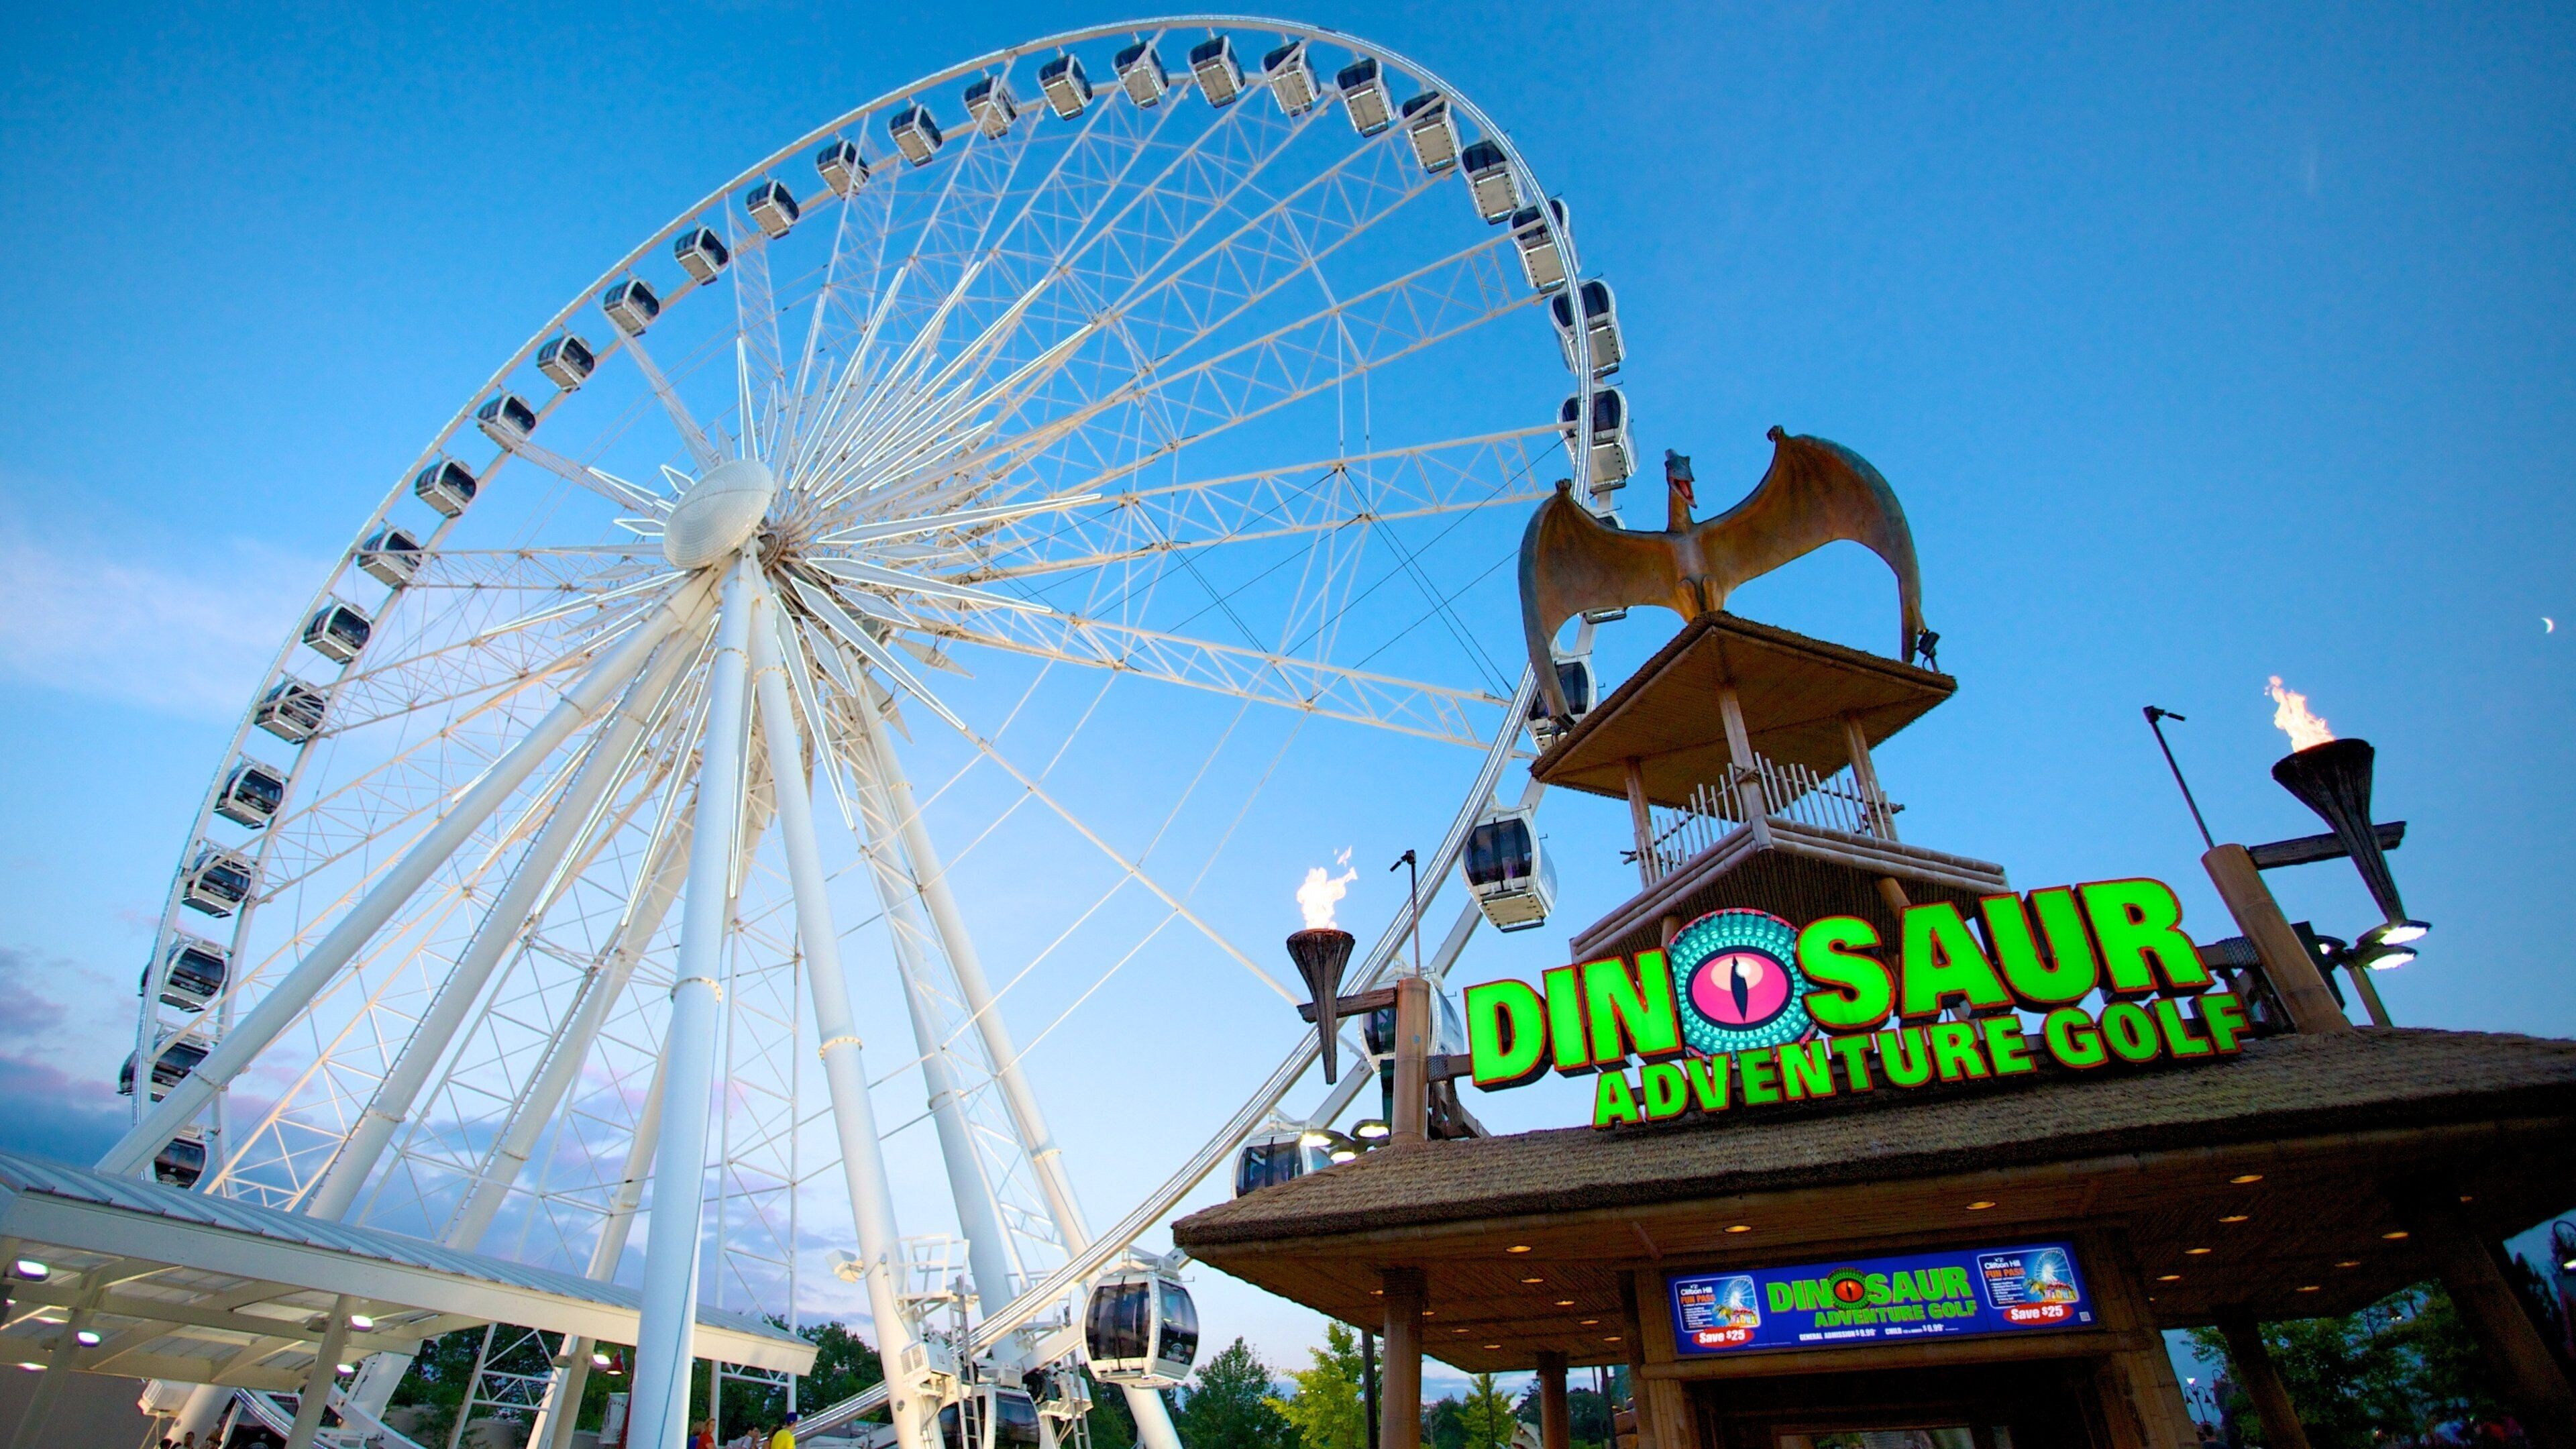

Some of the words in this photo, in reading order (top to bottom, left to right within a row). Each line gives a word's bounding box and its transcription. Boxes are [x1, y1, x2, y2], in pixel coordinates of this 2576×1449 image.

[1463, 877, 2216, 1088] DINOSAUR
[1592, 1014, 2038, 1130] ADVENTURE
[2043, 991, 2251, 1069] GOLF
[1766, 1266, 1974, 1313] DINOSAUR
[1815, 1305, 1926, 1328] ADVENTURE
[1927, 1300, 1977, 1320] GOLF
[2010, 1308, 2040, 1320] Save
[2041, 1305, 2063, 1318] $25
[1699, 1332, 1725, 1344] Save
[1726, 1329, 1746, 1341] $25
[1799, 1333, 1823, 1341] GENERAL
[1824, 1330, 1856, 1339] ADMISSION
